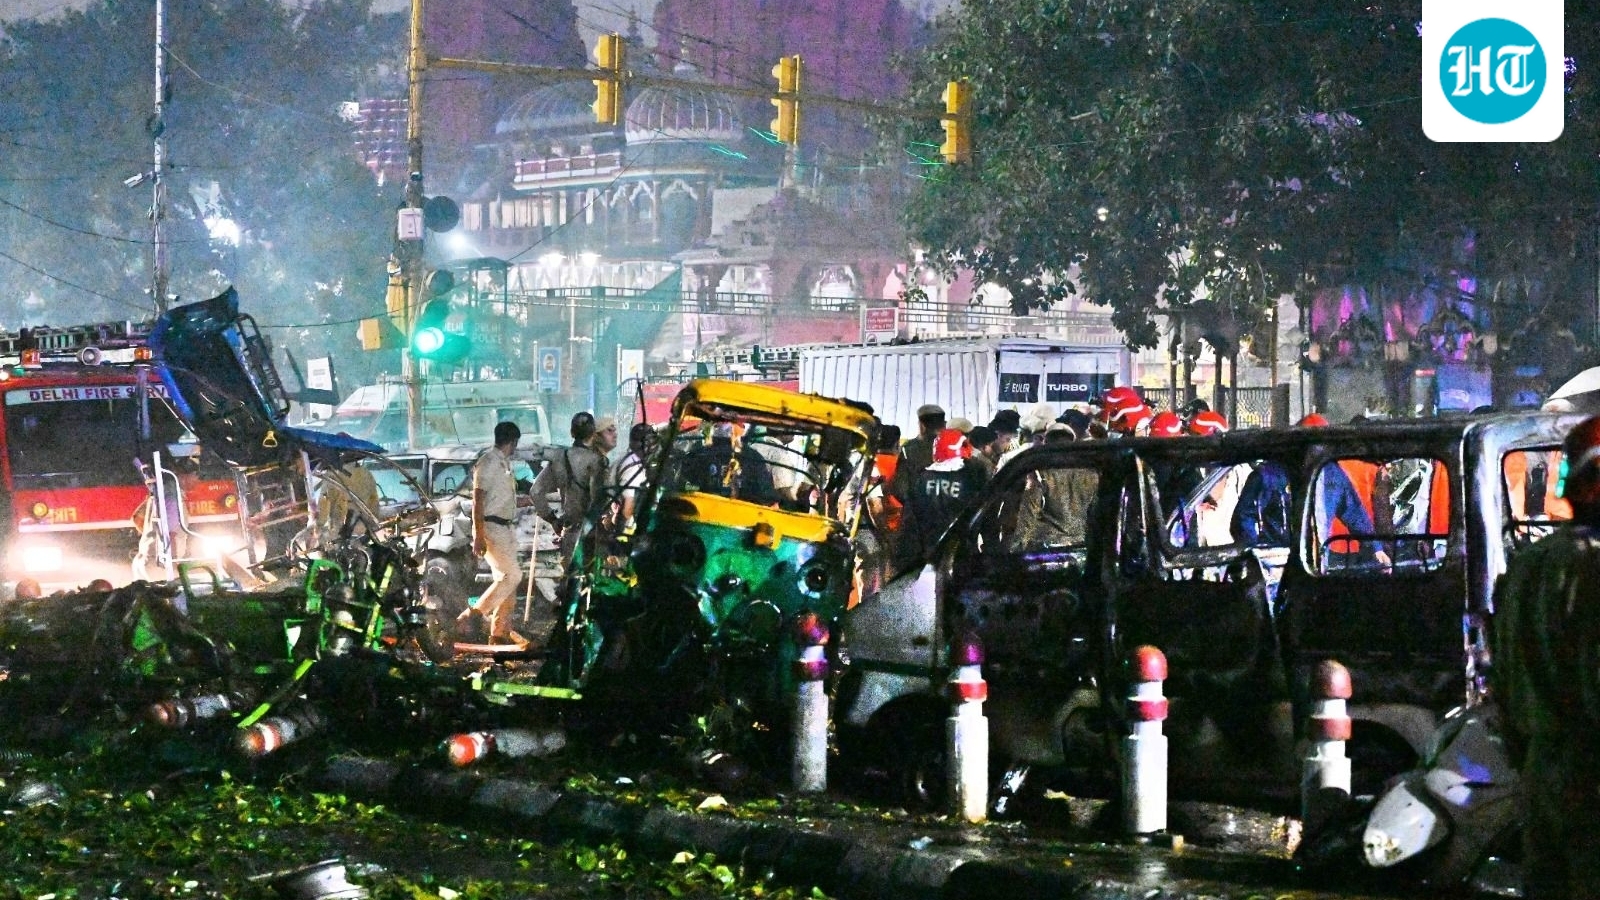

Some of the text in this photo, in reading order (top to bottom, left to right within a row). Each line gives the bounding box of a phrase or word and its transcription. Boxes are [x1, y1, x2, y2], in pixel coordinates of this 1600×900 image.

[30, 389, 78, 401] DELHI
[85, 388, 121, 399] FIRE
[1011, 383, 1030, 393] EULER
[1047, 384, 1088, 392] TURBO
[926, 479, 960, 498] FIRE
[189, 500, 216, 515] FIRE
